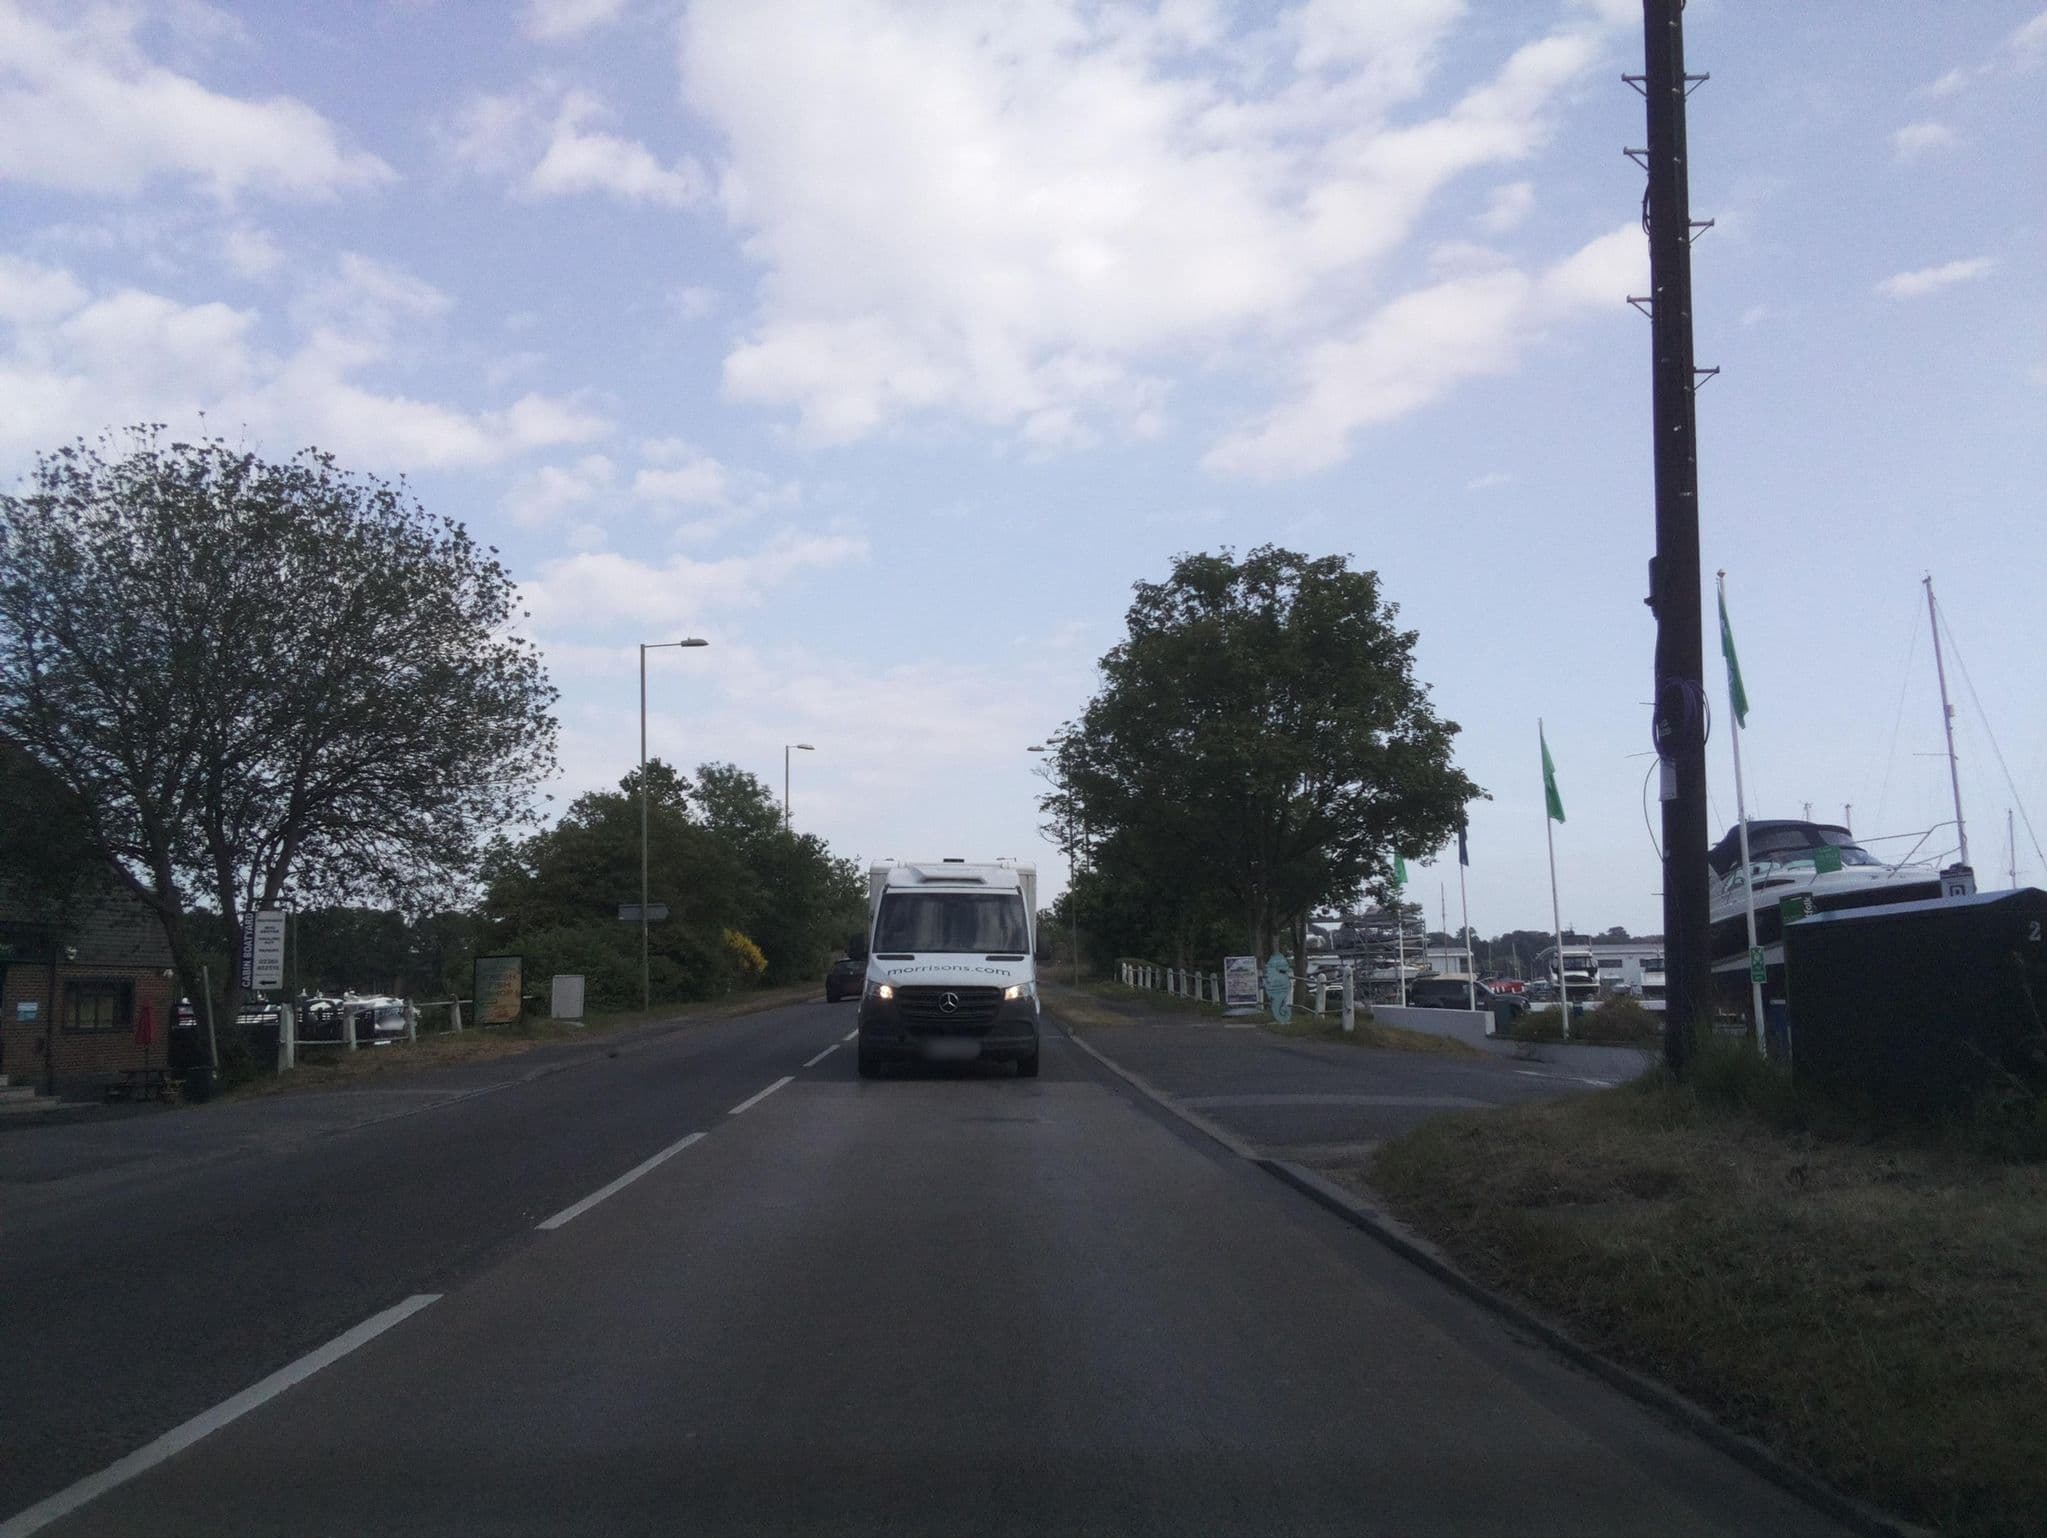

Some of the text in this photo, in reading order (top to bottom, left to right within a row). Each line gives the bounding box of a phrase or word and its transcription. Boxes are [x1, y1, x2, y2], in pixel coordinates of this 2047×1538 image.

[2029, 920, 2041, 941] 2
[241, 912, 254, 988] CABIN BOATYARD
[887, 964, 1011, 977] morrisons.com
